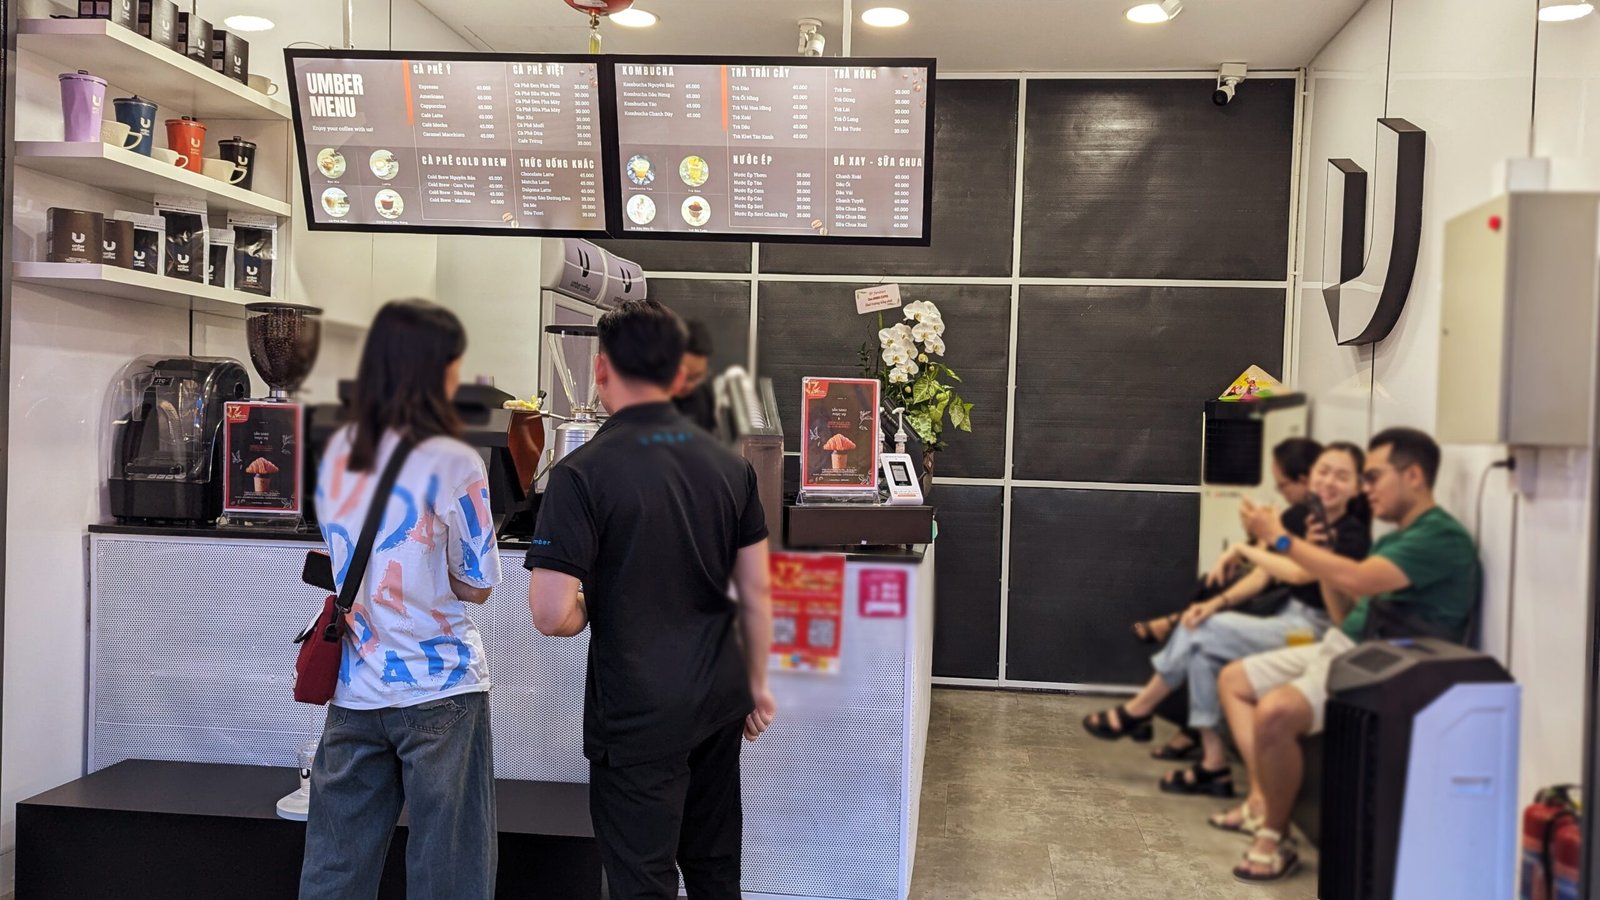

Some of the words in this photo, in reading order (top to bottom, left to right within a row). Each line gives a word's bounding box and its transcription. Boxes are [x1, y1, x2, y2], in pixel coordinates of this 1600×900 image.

[413, 63, 424, 74] CÀ
[428, 63, 443, 75] PHÊ
[513, 63, 524, 75] CÀ
[527, 63, 543, 75] PHÊ
[546, 63, 565, 77] VIỆT
[622, 66, 674, 76] KOMBUCHA
[732, 66, 747, 78] TRÀ
[751, 66, 770, 78] TRÁI
[774, 67, 790, 78] CÂY
[834, 67, 850, 79] TRÀ
[306, 73, 364, 95] UMBER
[309, 96, 356, 118] MENU
[422, 154, 434, 165] CÀ
[436, 154, 453, 166] PHÊ
[456, 156, 478, 166] COLD
[482, 157, 507, 167] BREW
[520, 157, 542, 167] THỨC
[546, 158, 568, 168] UỐNG
[572, 158, 595, 169] KHÁC
[762, 154, 772, 165] ÉP
[849, 156, 865, 166] XAY
[878, 155, 895, 167] SỮA
[900, 157, 922, 167] CHUA
